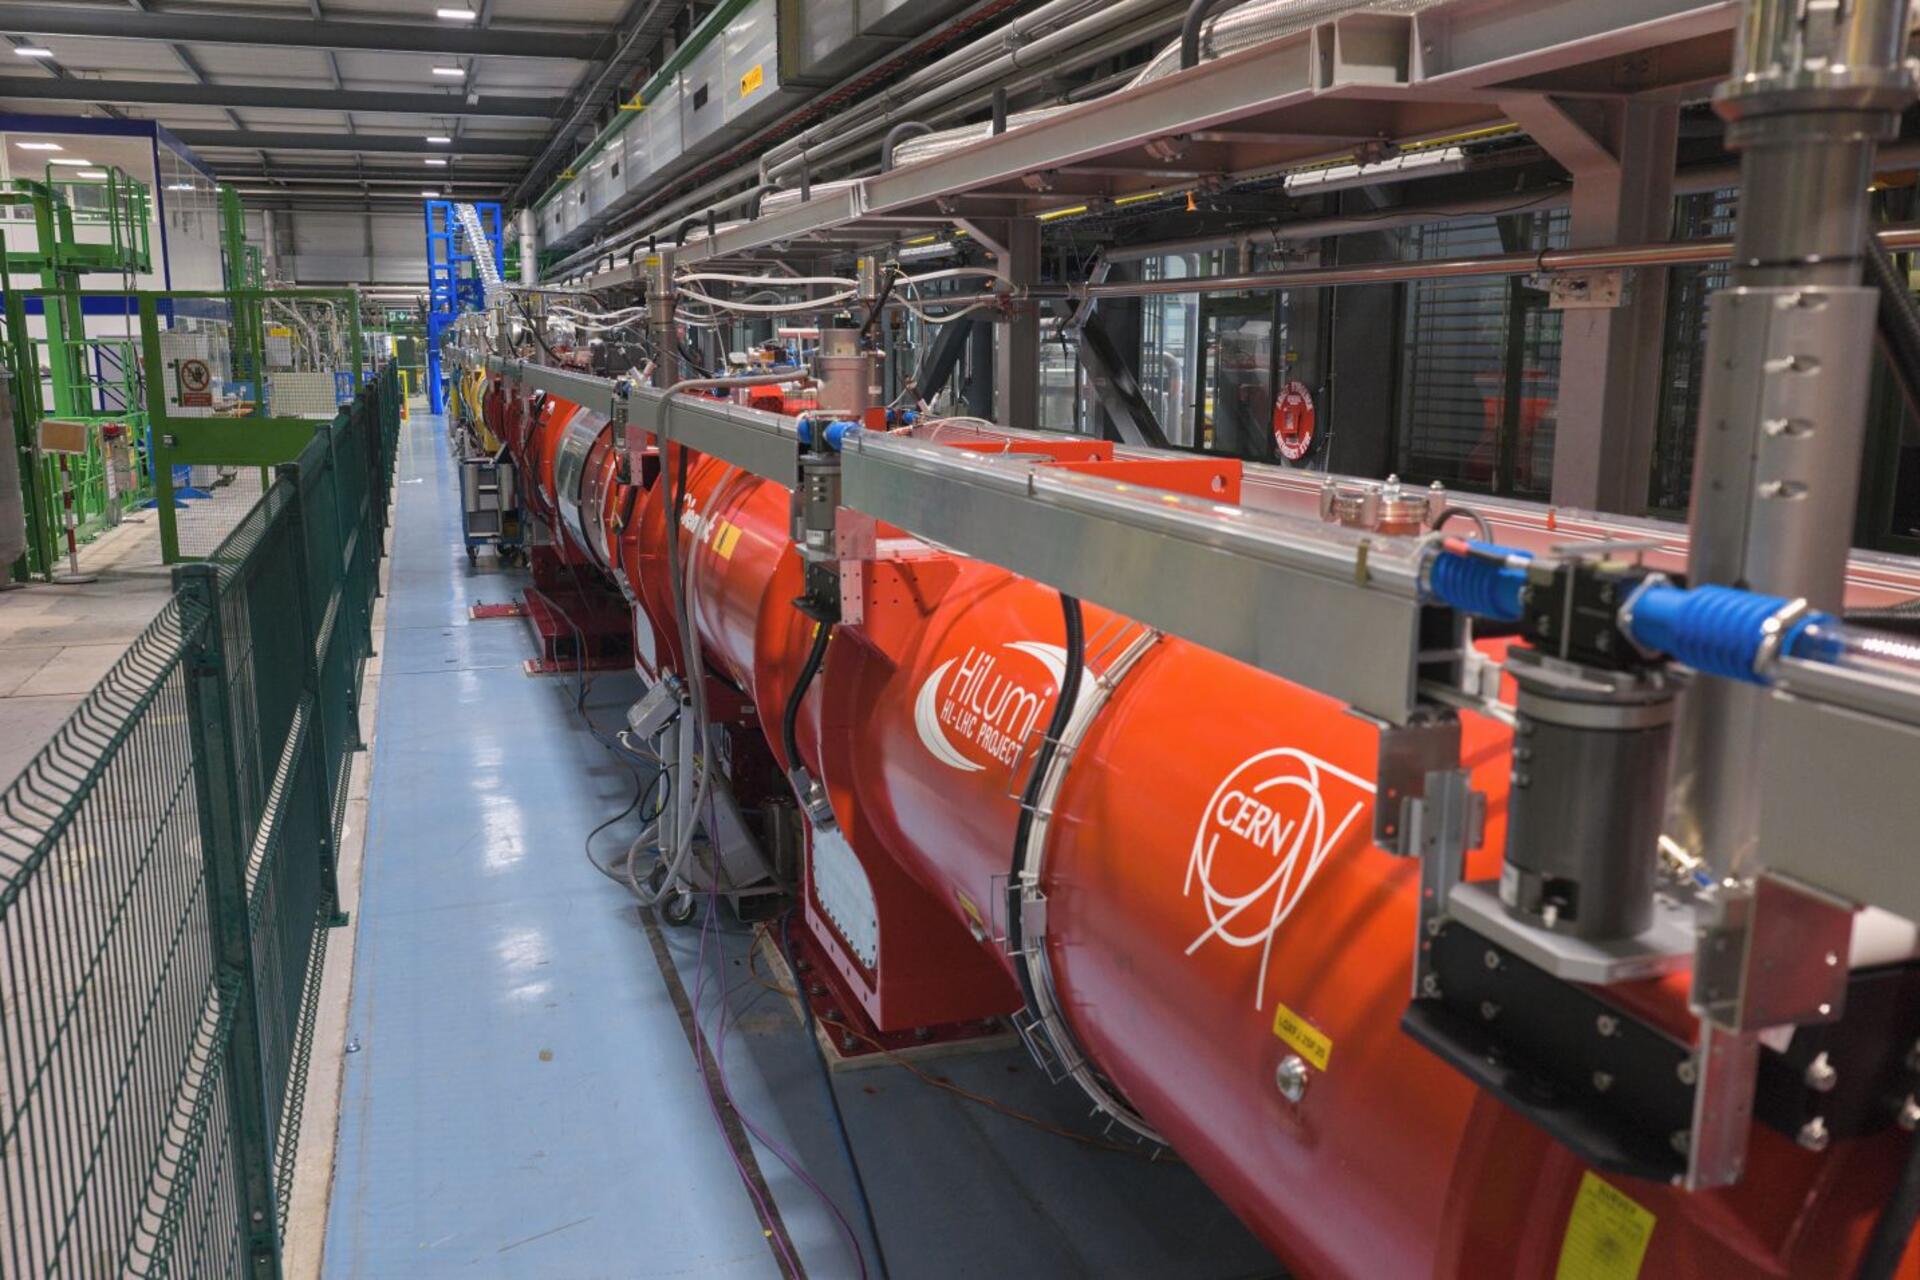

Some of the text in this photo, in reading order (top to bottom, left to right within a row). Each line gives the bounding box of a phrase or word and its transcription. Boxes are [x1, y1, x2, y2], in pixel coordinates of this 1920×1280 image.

[940, 699, 1023, 769] HL-LHC PROJECT
[1216, 789, 1295, 857] CERN
